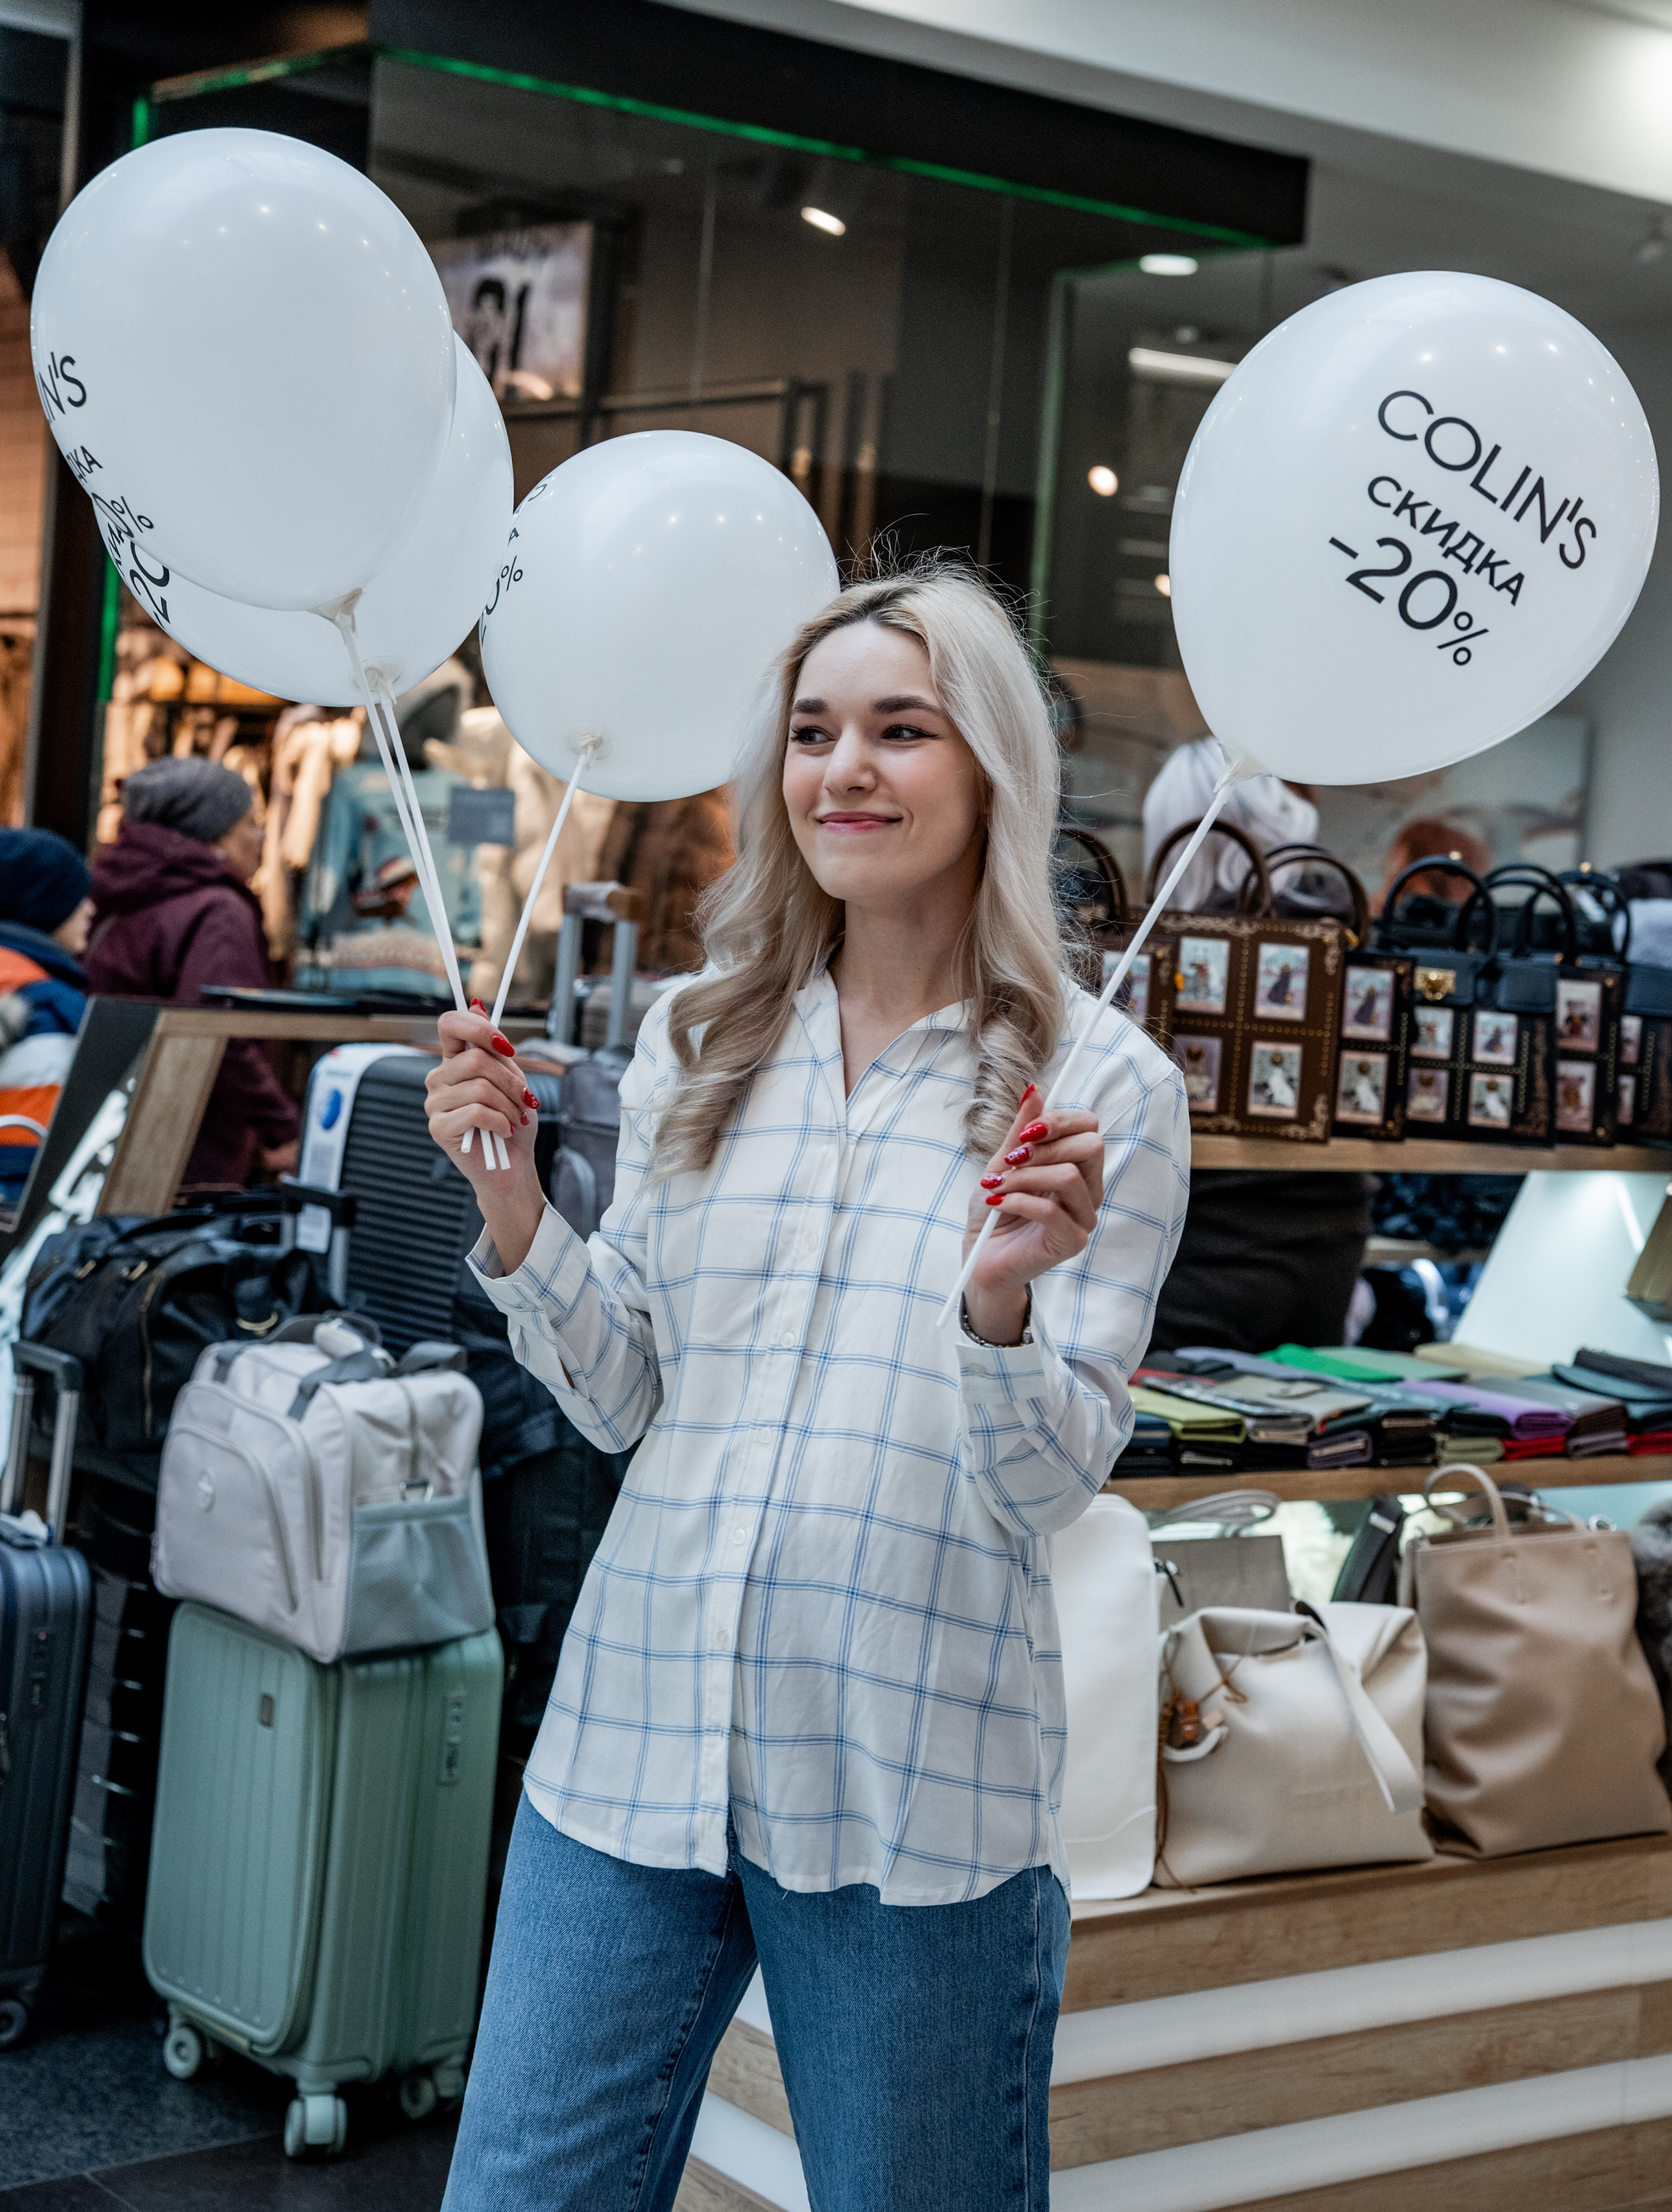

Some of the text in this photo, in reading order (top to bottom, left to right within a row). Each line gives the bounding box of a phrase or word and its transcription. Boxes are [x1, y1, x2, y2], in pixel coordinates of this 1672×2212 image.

[1368, 476, 1525, 606] СКИДКА
[1378, 390, 1597, 570] COLIN'S
[129, 540, 171, 629] -20
[1328, 536, 1489, 666] -20%
